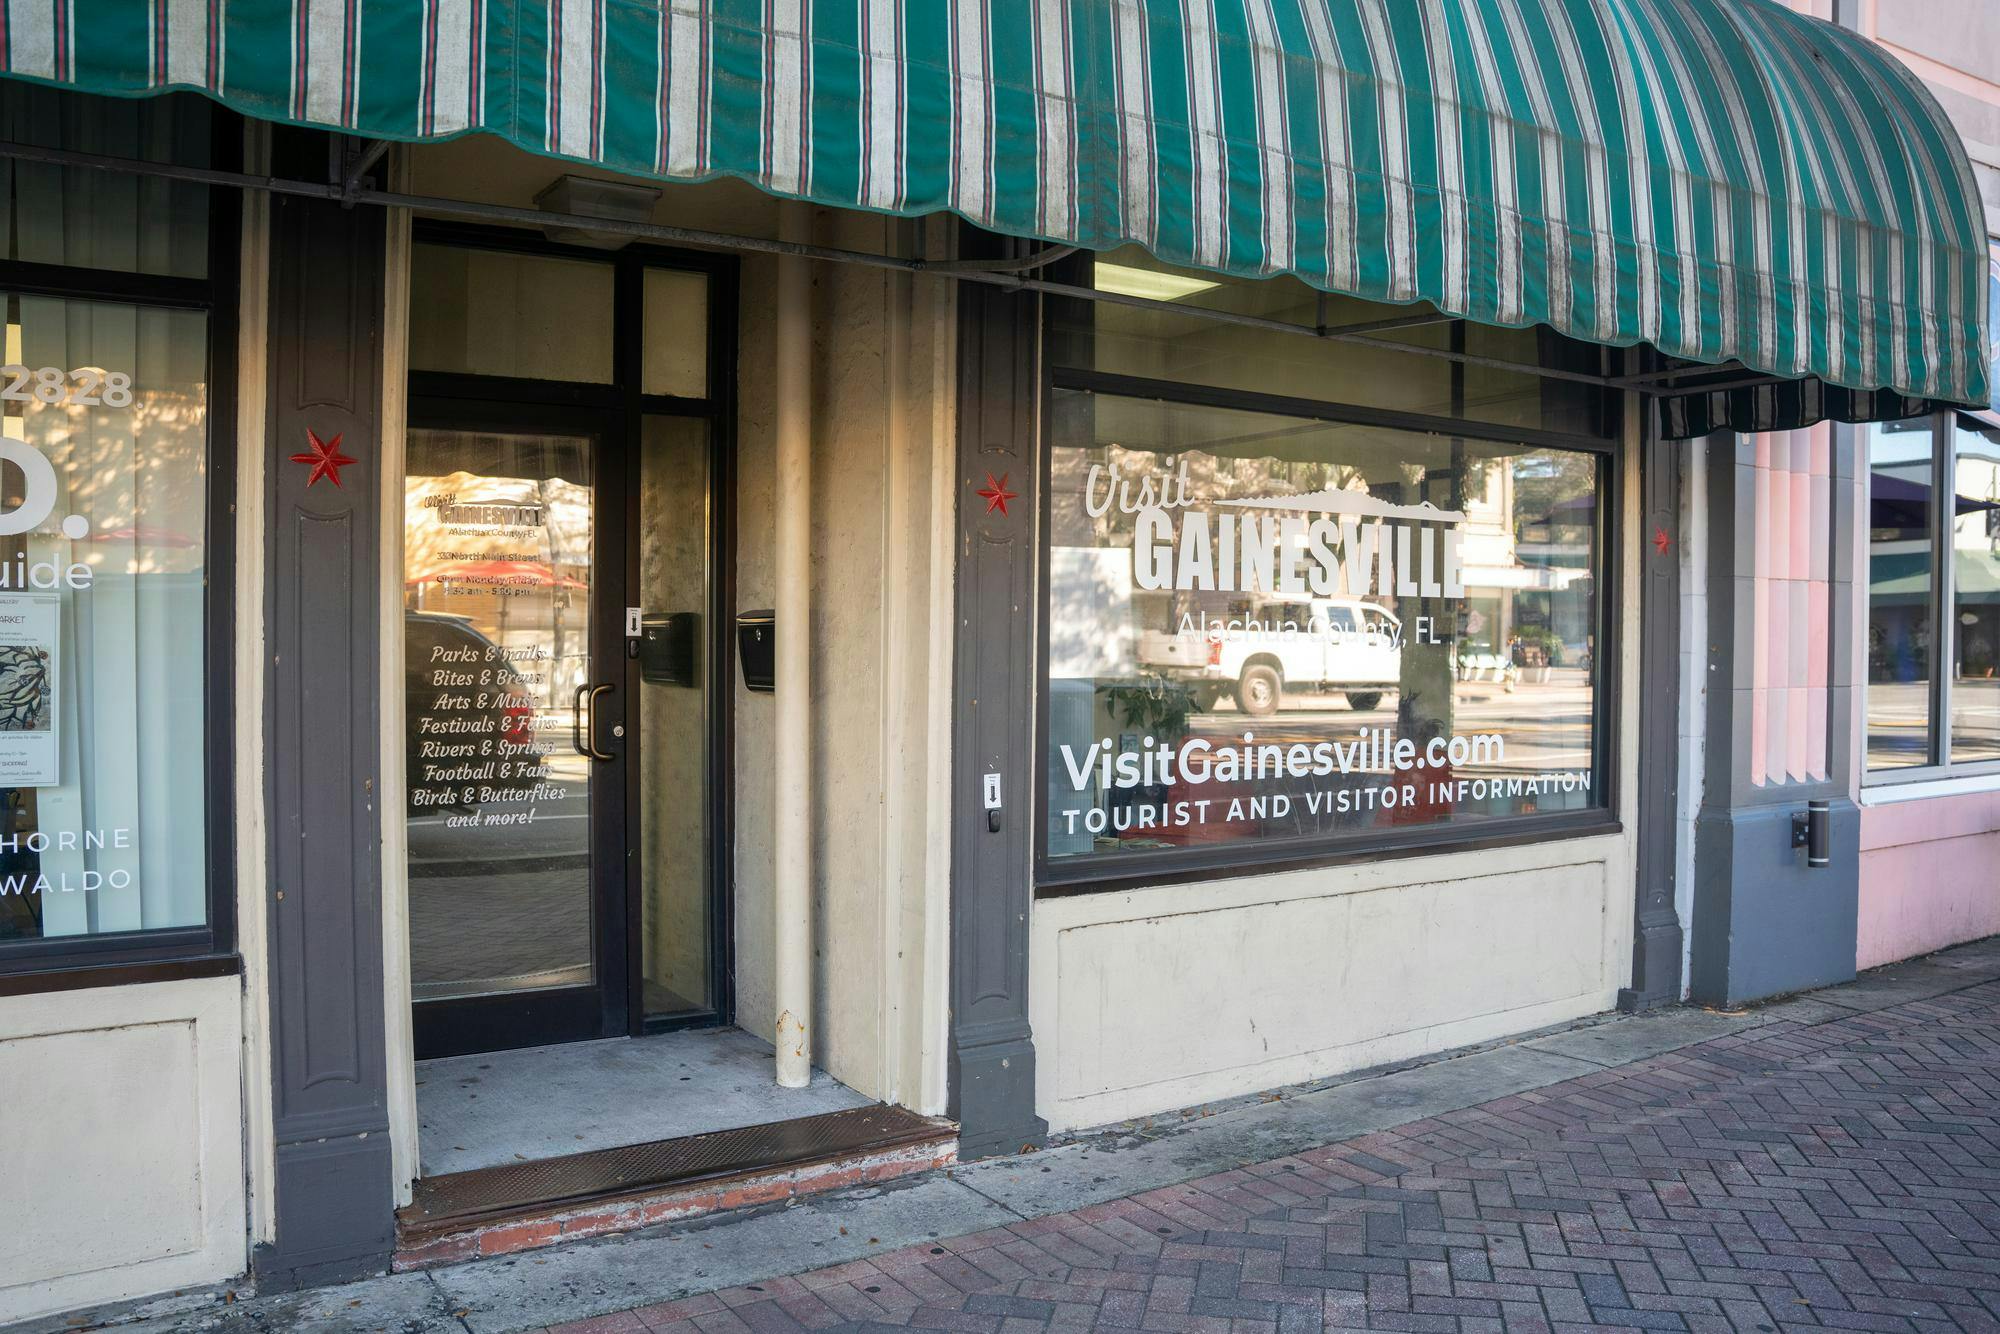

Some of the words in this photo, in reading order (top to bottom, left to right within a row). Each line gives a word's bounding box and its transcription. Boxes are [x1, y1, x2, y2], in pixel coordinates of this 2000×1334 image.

[1085, 458, 1196, 518] Visit
[1134, 508, 1466, 598] GAINESVILLE
[1174, 611, 1298, 643] Alachua
[1416, 617, 1441, 644] FL
[431, 645, 479, 663] Parks
[485, 646, 496, 662] &
[433, 670, 474, 686] Bites
[480, 670, 491, 686] &
[433, 693, 471, 710] Arts
[477, 693, 488, 709] &
[491, 692, 539, 709] Music
[420, 715, 495, 734] Festivals
[501, 716, 512, 732] &
[421, 741, 476, 758] Rivers
[481, 740, 492, 756] &
[497, 739, 555, 760] Springs
[1060, 727, 1505, 791] VisitGainesville.com
[425, 762, 495, 782] Football
[500, 763, 511, 779] &
[516, 761, 554, 779] Fans
[414, 787, 458, 806] Birds
[463, 787, 475, 804] &
[480, 784, 566, 803] Butterflies
[1062, 799, 1211, 835] TOURIST
[1226, 793, 1291, 822] AND
[1305, 785, 1416, 815] VISITOR
[1429, 770, 1592, 805] INFORMATION
[447, 809, 481, 828] and
[484, 808, 536, 828] more!
[0, 828, 131, 854] HORNE
[0, 869, 131, 896] WALDO
